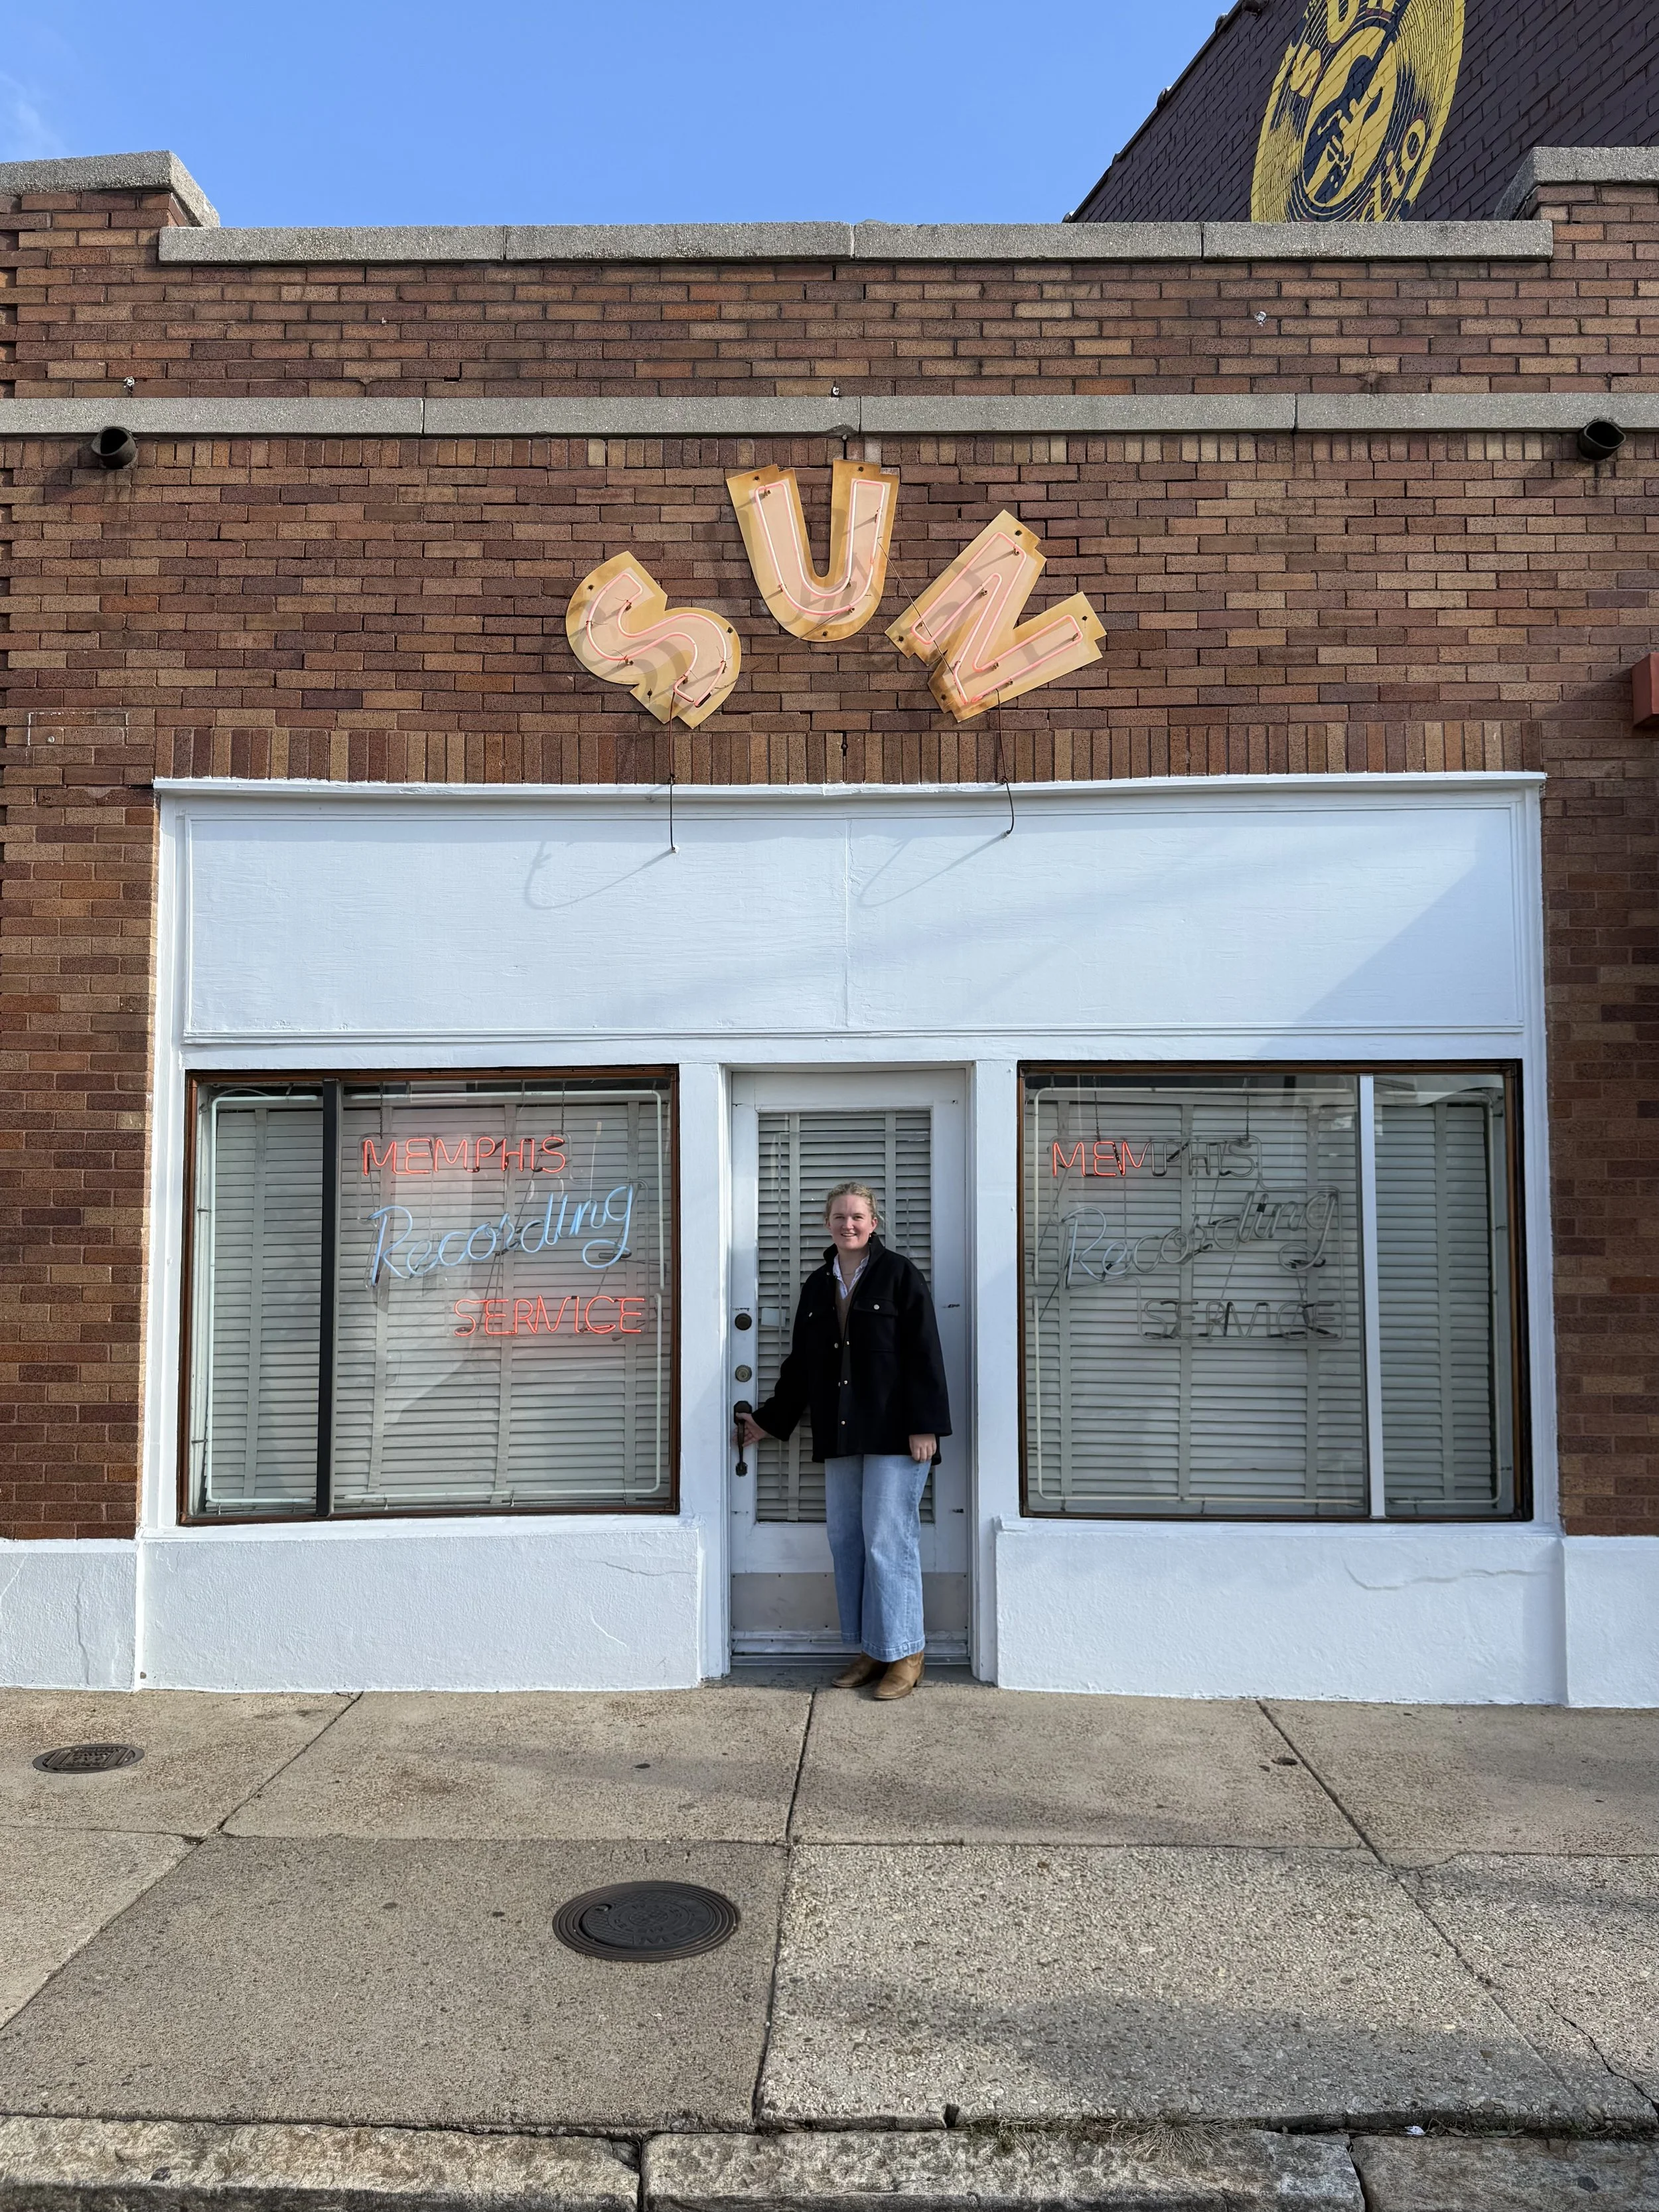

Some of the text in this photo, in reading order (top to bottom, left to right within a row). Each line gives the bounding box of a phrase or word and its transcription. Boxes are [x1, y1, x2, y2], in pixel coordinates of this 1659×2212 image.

[1289, 0, 1396, 98] SU
[565, 460, 1104, 729] SUN
[363, 1136, 566, 1176] MEMPHIS
[1052, 1140, 1256, 1177] MEMPHIS
[367, 1185, 633, 1287] Recording
[1061, 1190, 1338, 1290] Recording
[454, 1295, 642, 1336] SERVICE
[1143, 1299, 1338, 1339] SERVICE
